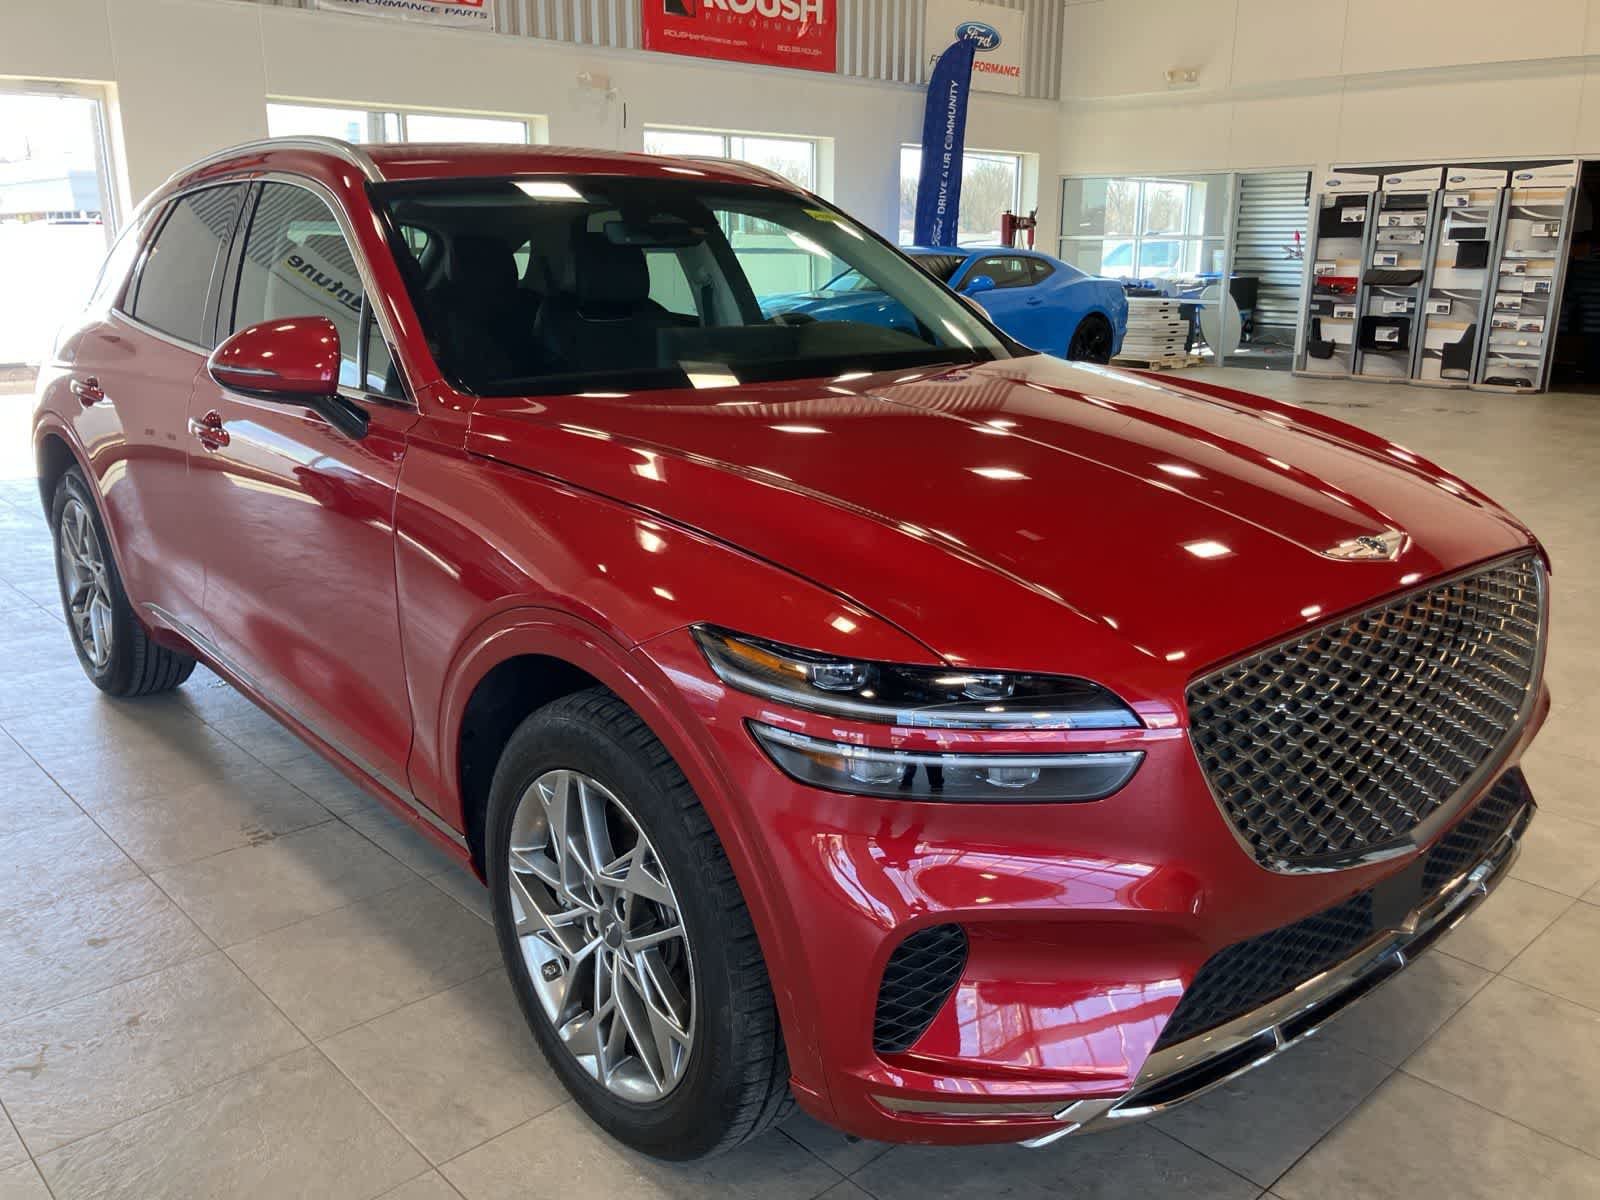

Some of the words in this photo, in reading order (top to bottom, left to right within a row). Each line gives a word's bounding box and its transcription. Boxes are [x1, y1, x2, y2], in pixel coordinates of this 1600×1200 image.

[344, 0, 442, 14] ORMANCE
[445, 7, 488, 19] PARTS
[964, 25, 993, 47] Ford
[973, 61, 1021, 77] FORMANCE
[943, 80, 960, 150] COMMUNITY
[943, 153, 952, 169] UR
[937, 179, 949, 214] DRIVE
